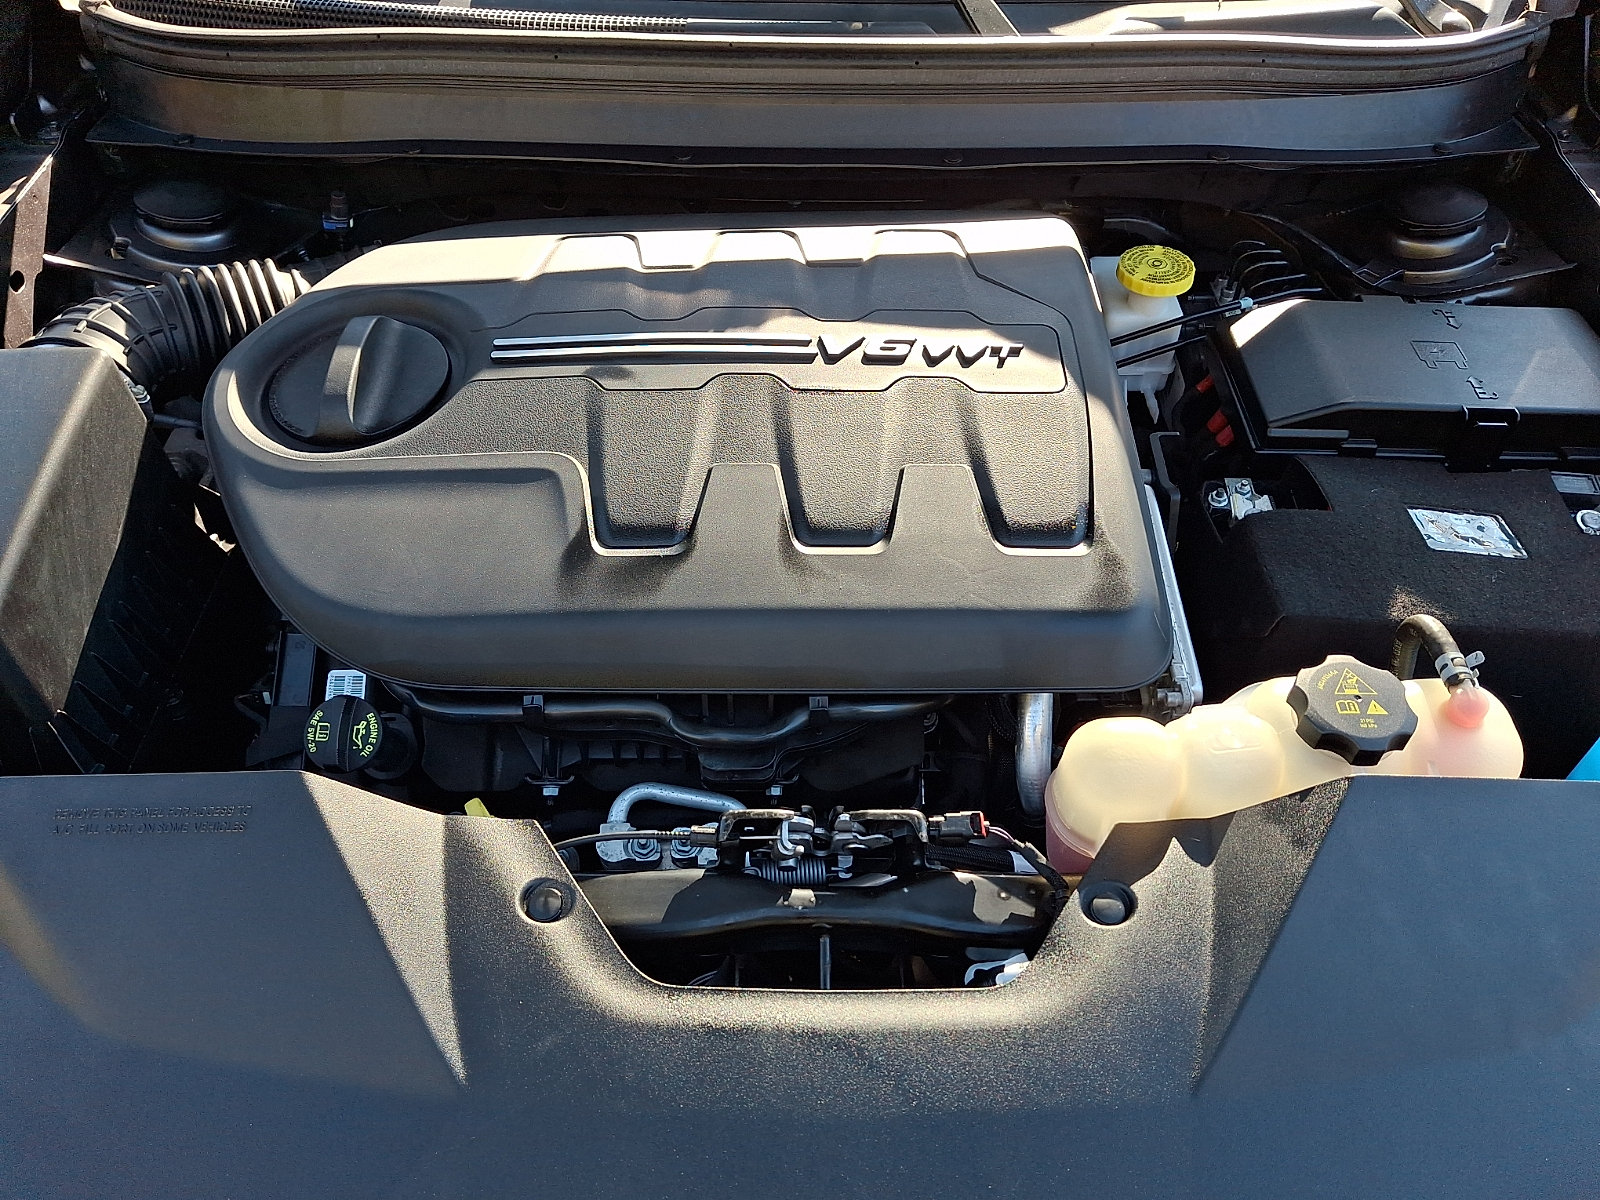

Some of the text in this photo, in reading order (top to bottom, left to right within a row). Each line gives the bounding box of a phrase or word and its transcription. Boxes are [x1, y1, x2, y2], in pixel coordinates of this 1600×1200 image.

[817, 336, 1025, 369] V6 VVT
[307, 710, 323, 752] SAE 5W-20
[360, 712, 378, 757] ENGINE OIL
[51, 820, 247, 835] A/C FILL PORT ON SOME VEHICLES
[130, 806, 165, 819] PANEL
[166, 806, 190, 818] FOR
[190, 805, 235, 818] ACCESS
[236, 804, 252, 816] TO
